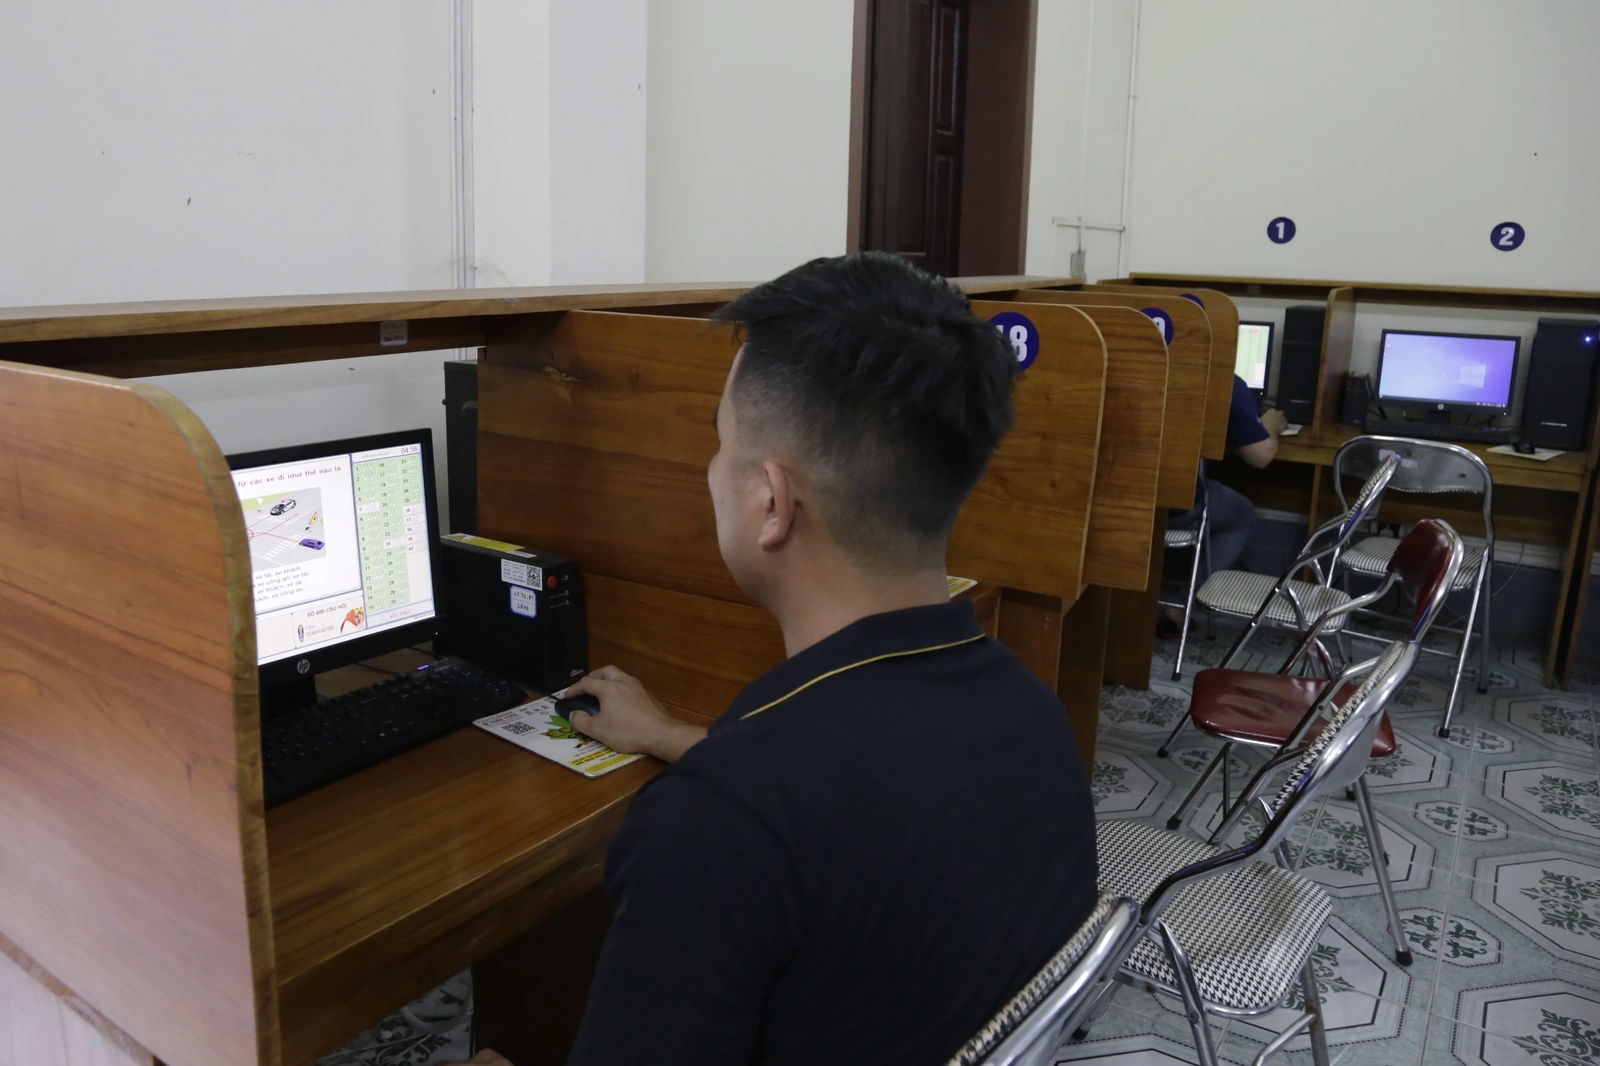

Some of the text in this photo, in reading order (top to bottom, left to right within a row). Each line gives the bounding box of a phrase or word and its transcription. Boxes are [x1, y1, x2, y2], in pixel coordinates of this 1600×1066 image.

[1276, 222, 1284, 239] 1
[1499, 227, 1515, 246] 2
[401, 446, 418, 454] 04:56
[297, 659, 310, 674] hp
